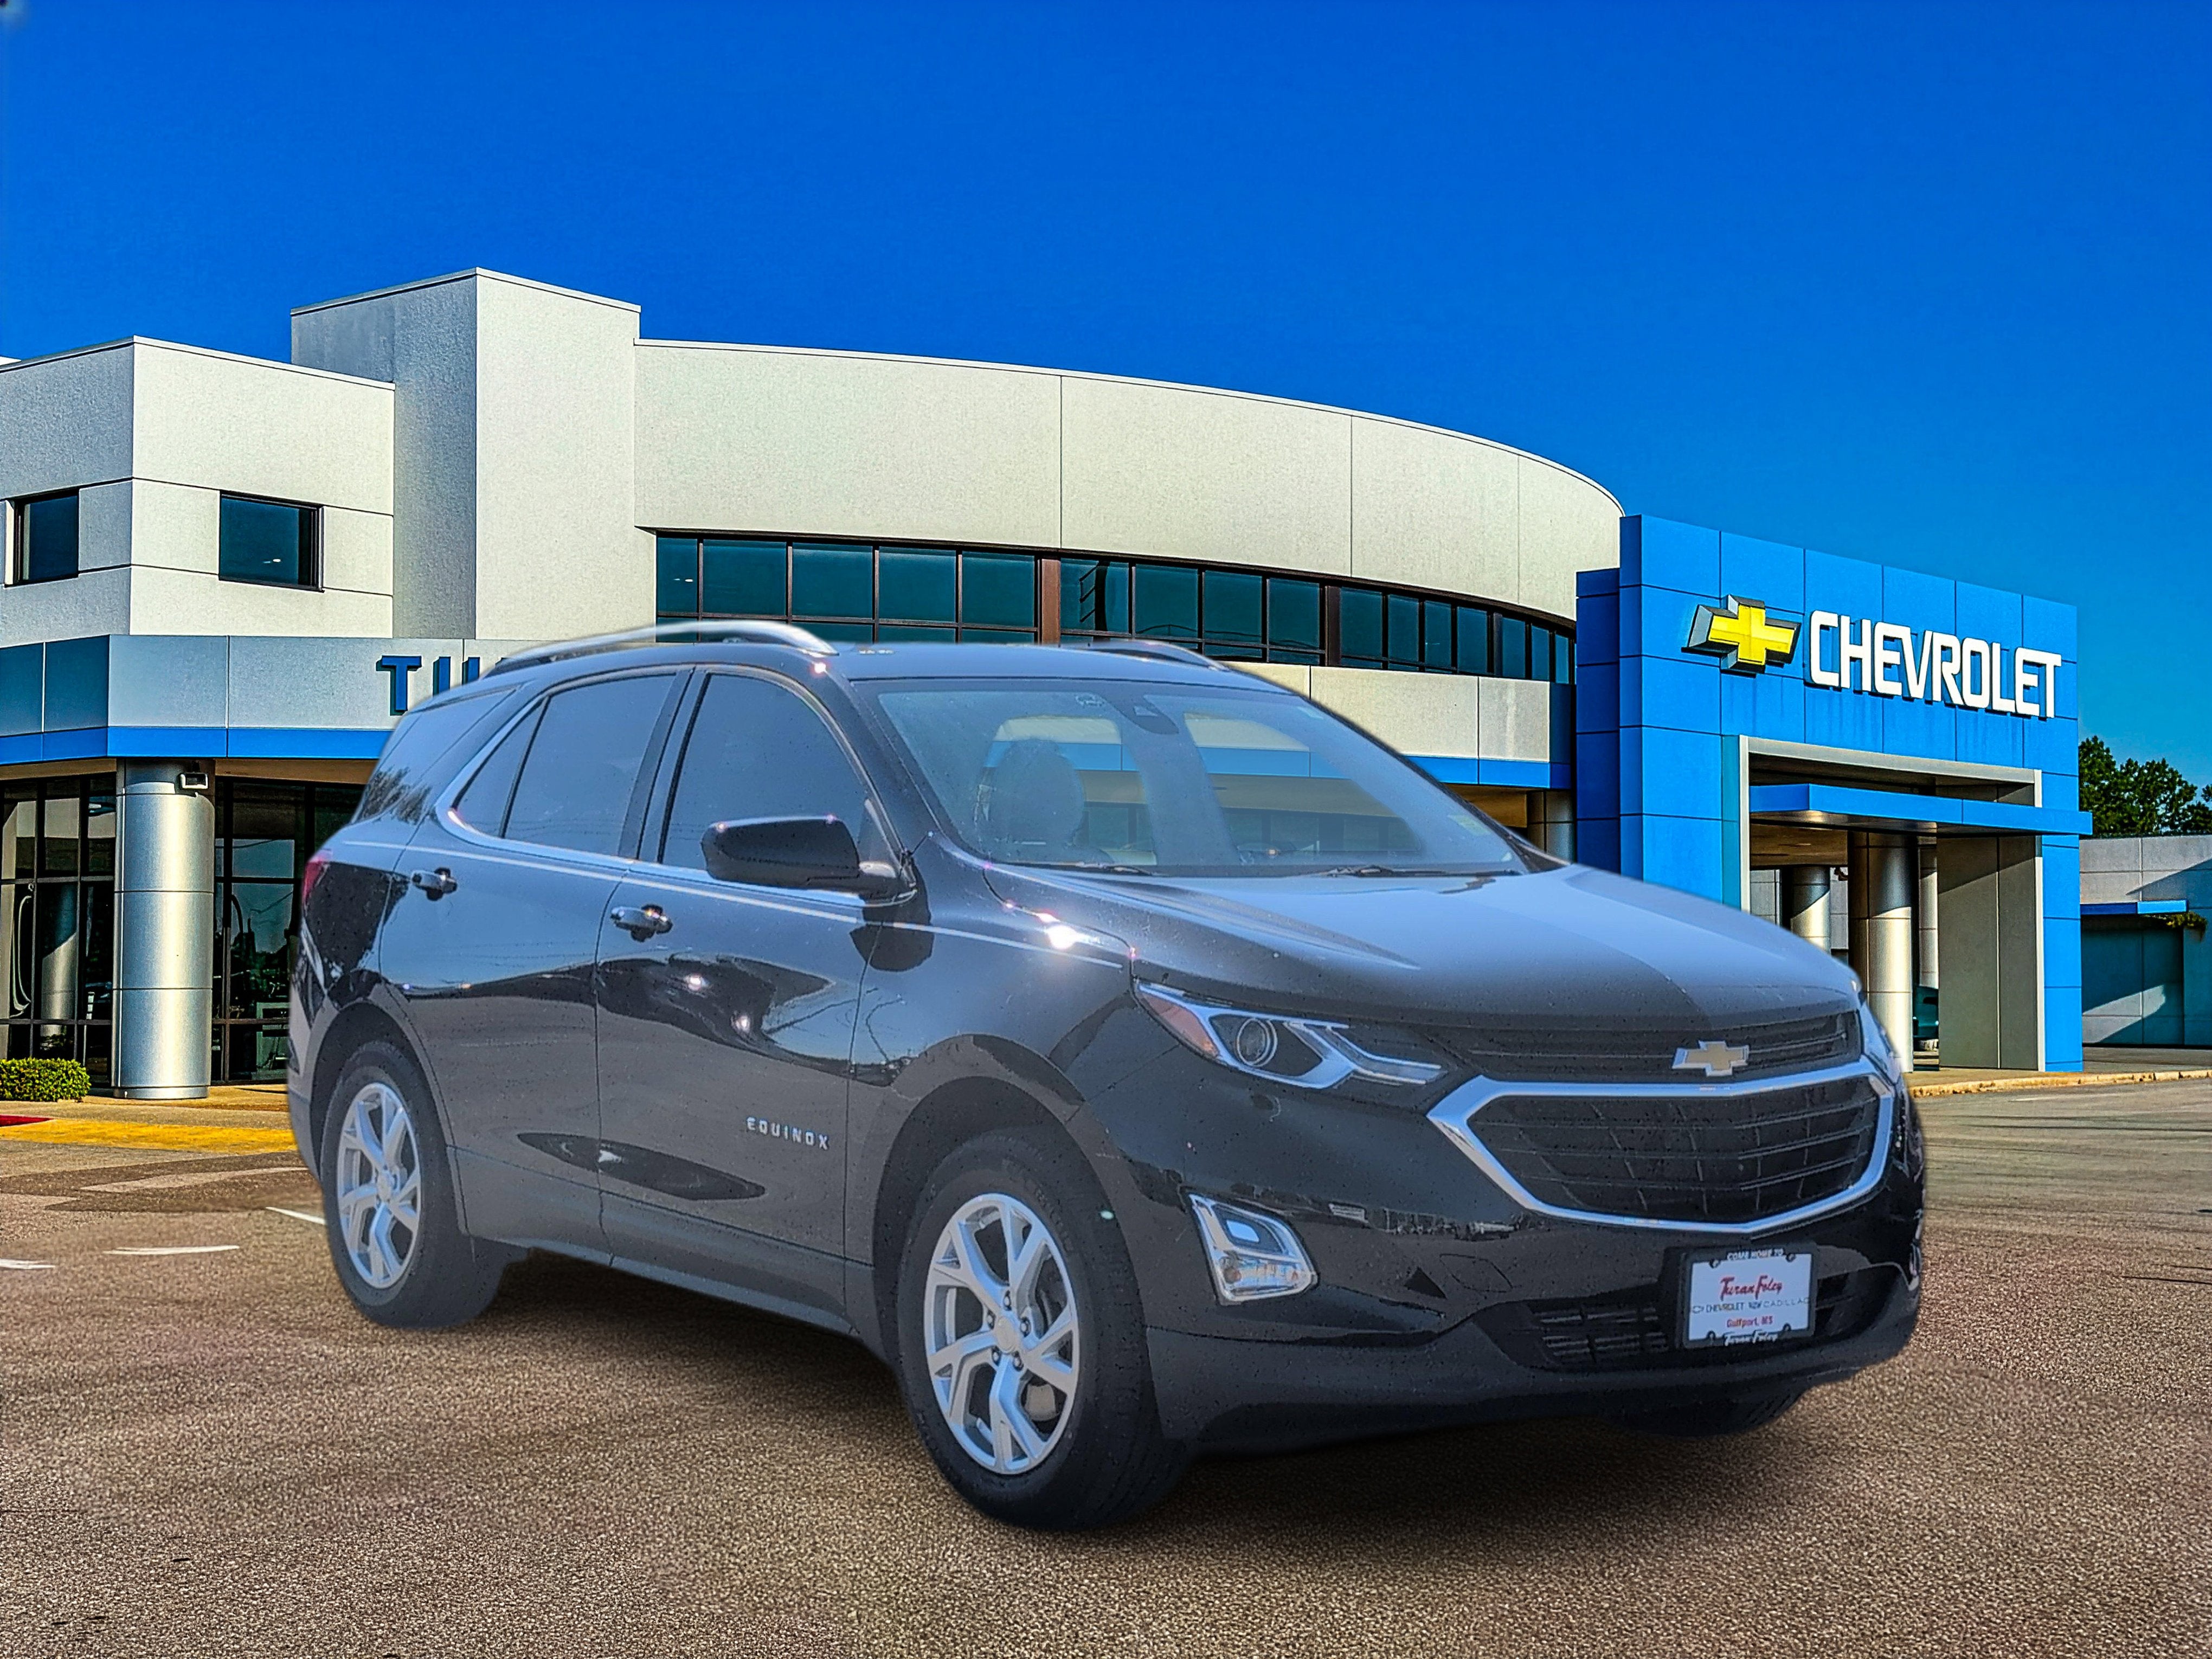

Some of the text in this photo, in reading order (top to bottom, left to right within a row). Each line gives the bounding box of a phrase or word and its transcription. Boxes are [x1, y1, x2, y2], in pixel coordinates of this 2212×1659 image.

[1809, 609, 2062, 719] CHEVROLET
[747, 1116, 829, 1150] EQUINOX
[1720, 1276, 1754, 1301] Turan
[1705, 1297, 1810, 1313] CHEVROLET CADILLAC
